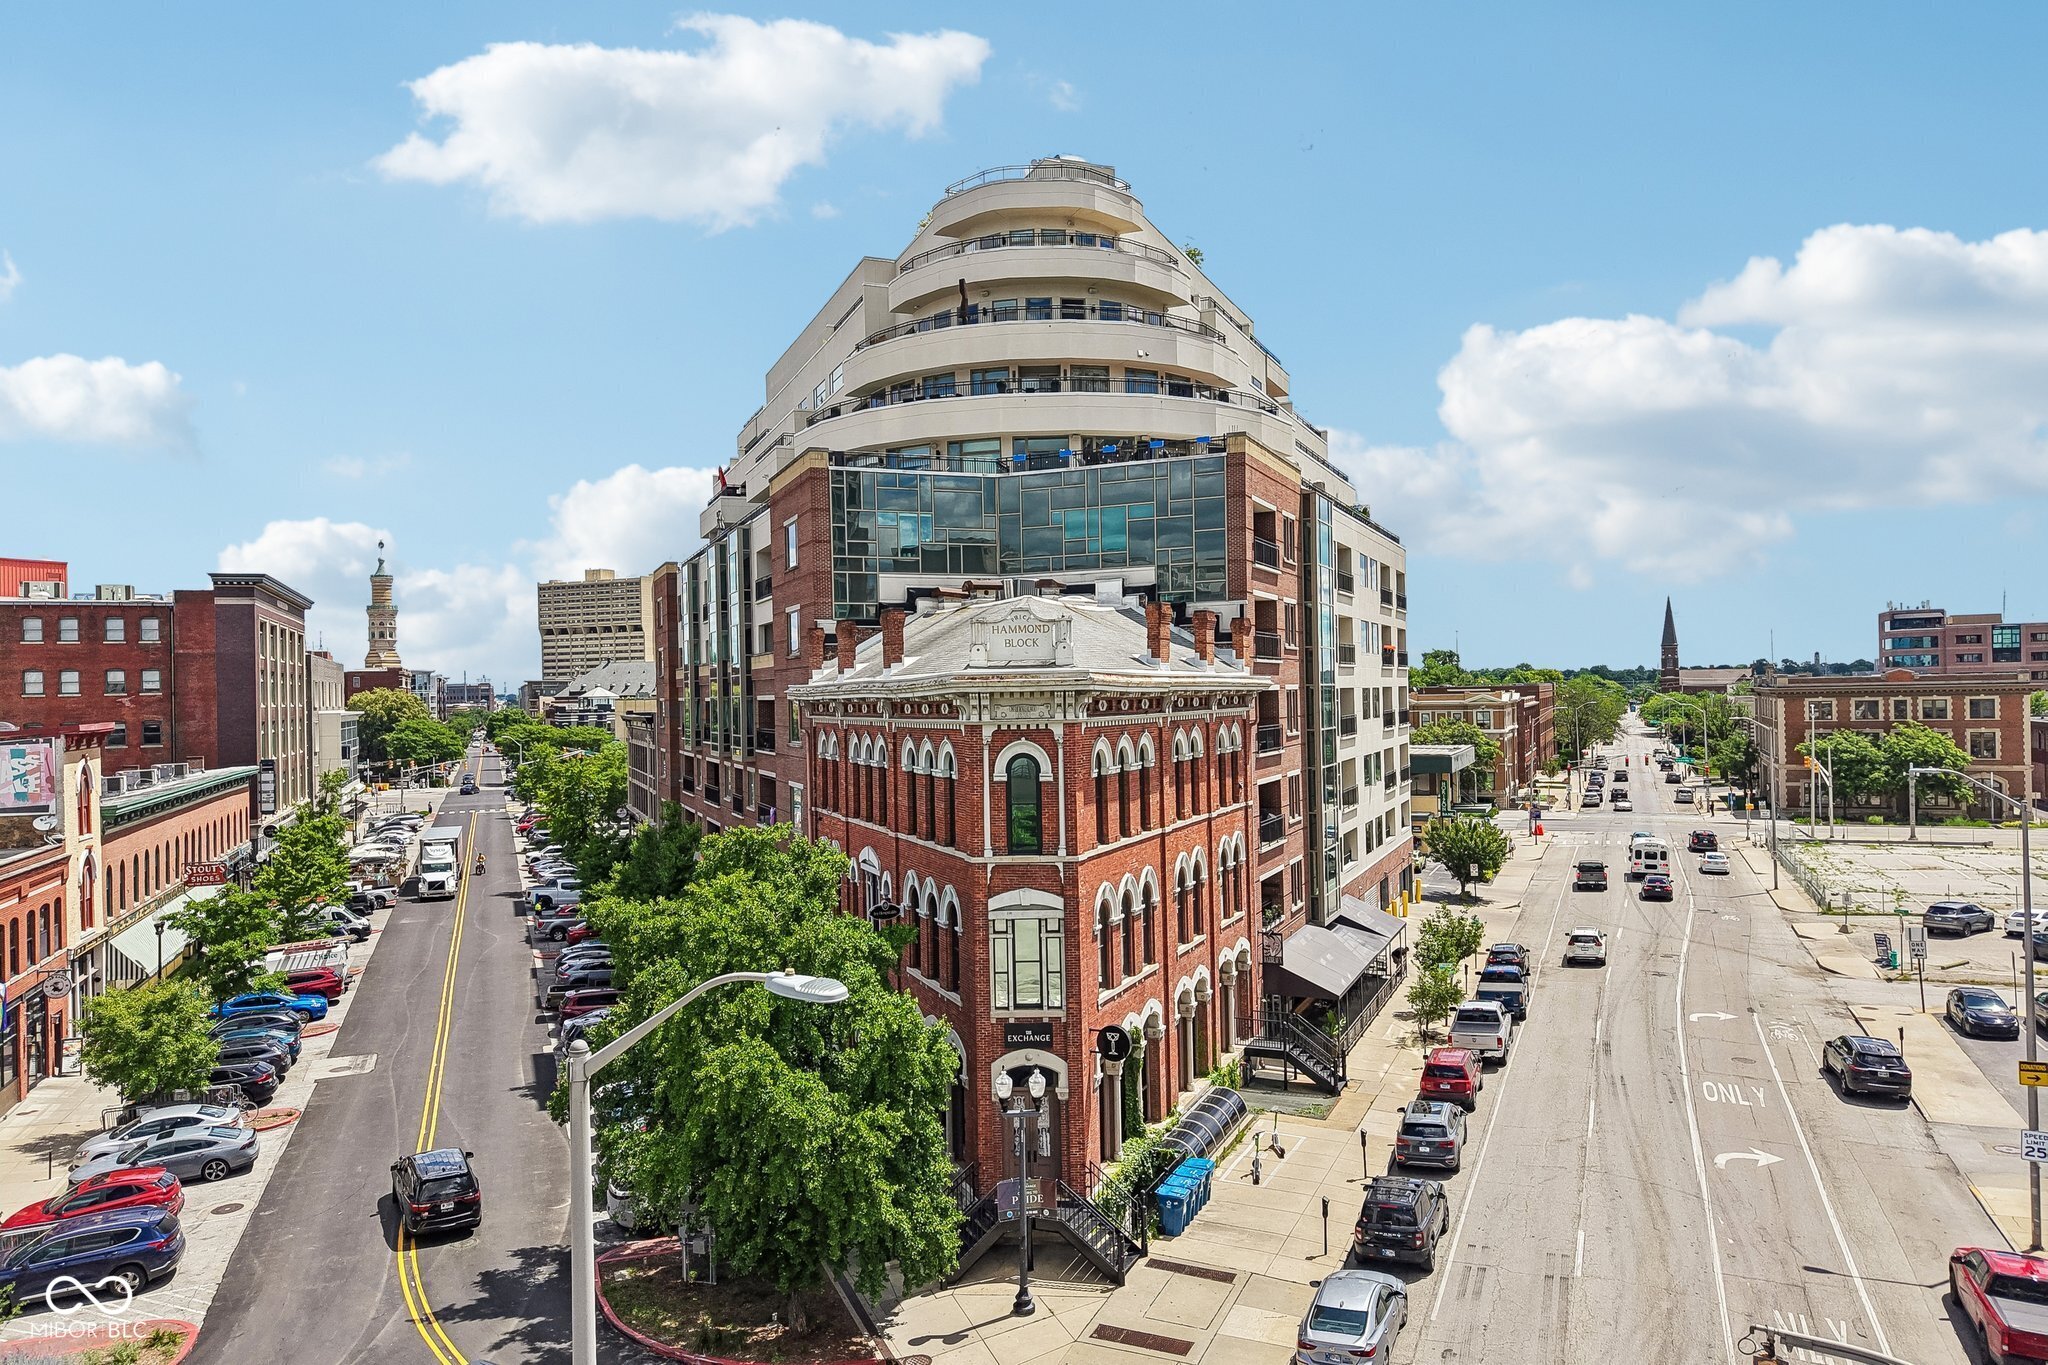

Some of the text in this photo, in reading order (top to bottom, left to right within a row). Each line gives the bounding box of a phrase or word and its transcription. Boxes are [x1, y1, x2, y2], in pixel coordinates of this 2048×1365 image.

[991, 624, 1050, 635] HAMMOND
[1004, 637, 1039, 648] BLOCK
[185, 863, 226, 875] STOUT'S
[191, 875, 220, 883] SHOES
[1007, 1034, 1051, 1042] EXCHANGE
[2020, 1063, 2047, 1071] DONATIONS
[1702, 1081, 1766, 1108] ONLY
[2024, 1132, 2048, 1141] SPEED
[2026, 1139, 2045, 1147] LIMIT
[2024, 1146, 2047, 1159] 25
[1012, 1194, 1044, 1205] PIDE
